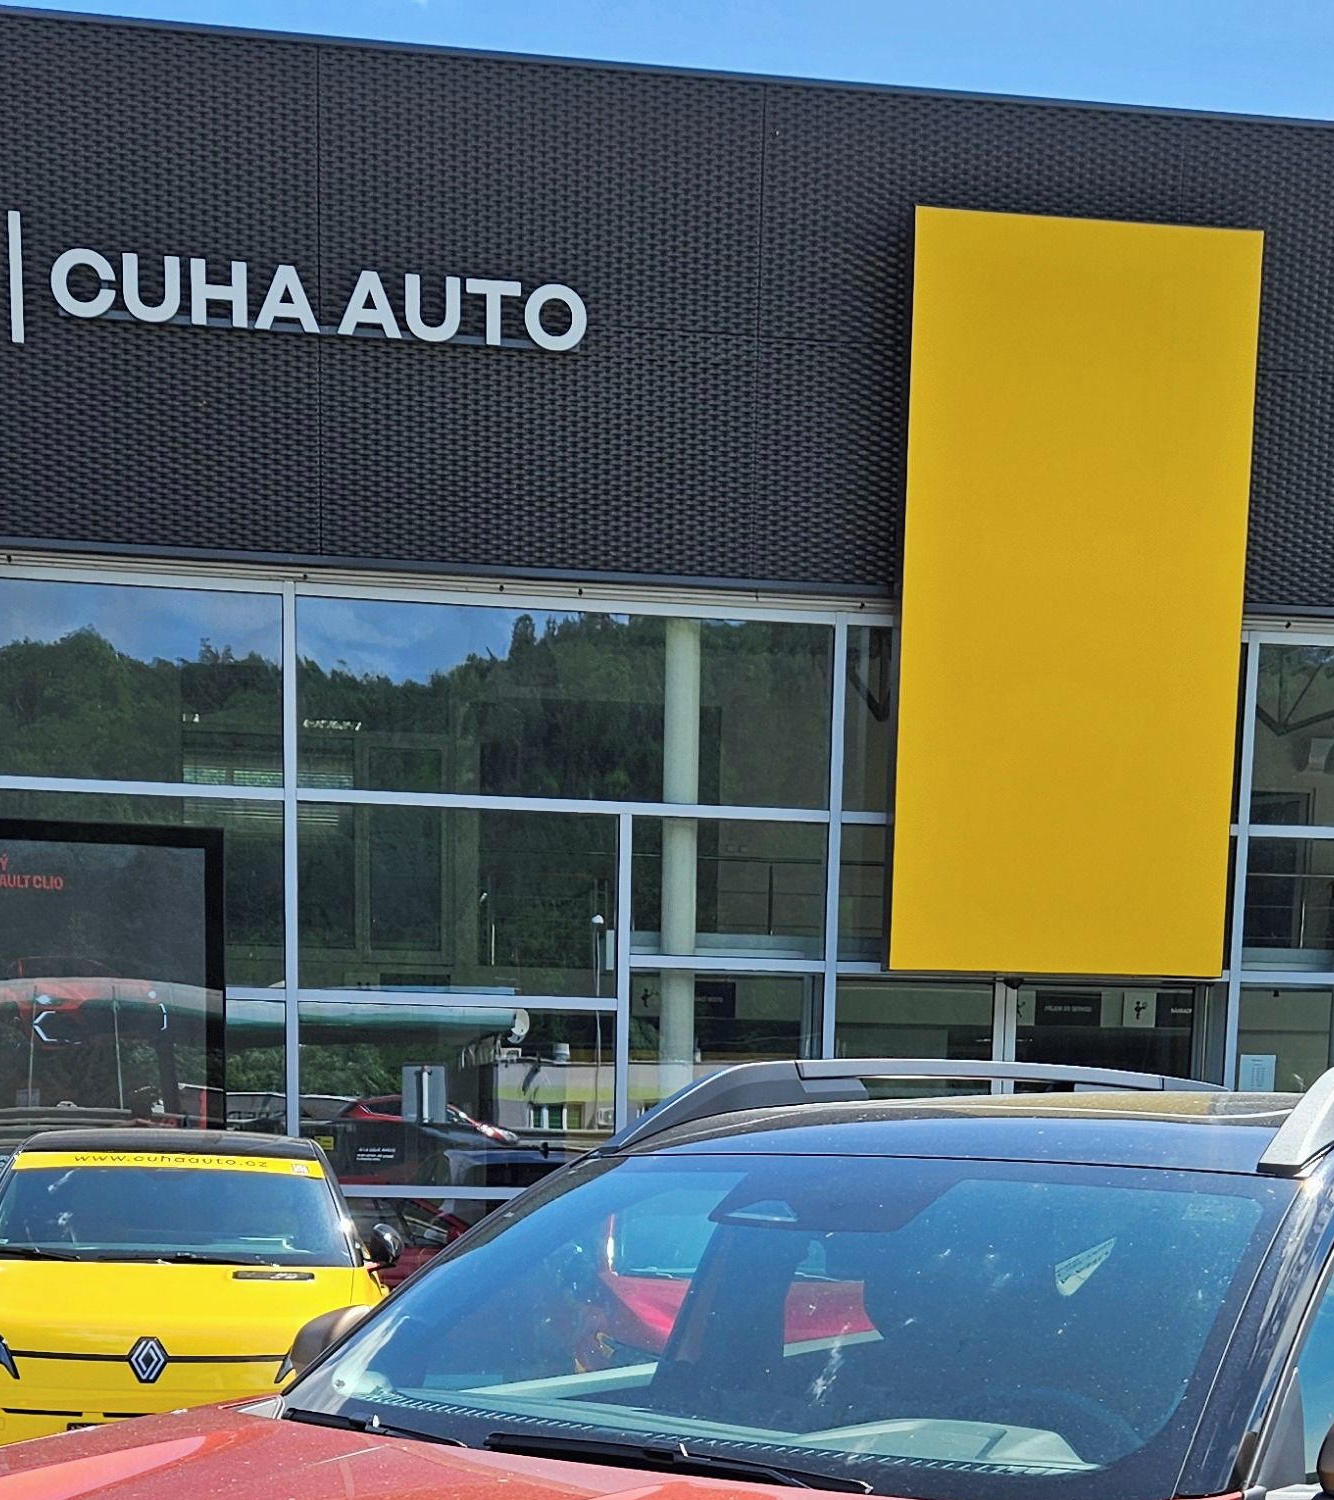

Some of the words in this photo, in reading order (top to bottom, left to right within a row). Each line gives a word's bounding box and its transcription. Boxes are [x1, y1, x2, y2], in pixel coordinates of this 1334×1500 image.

[50, 248, 319, 334] CUHA
[338, 270, 587, 351] AUTO
[32, 875, 64, 890] CLIO
[74, 1154, 268, 1168] www.cuhaauto.cz
